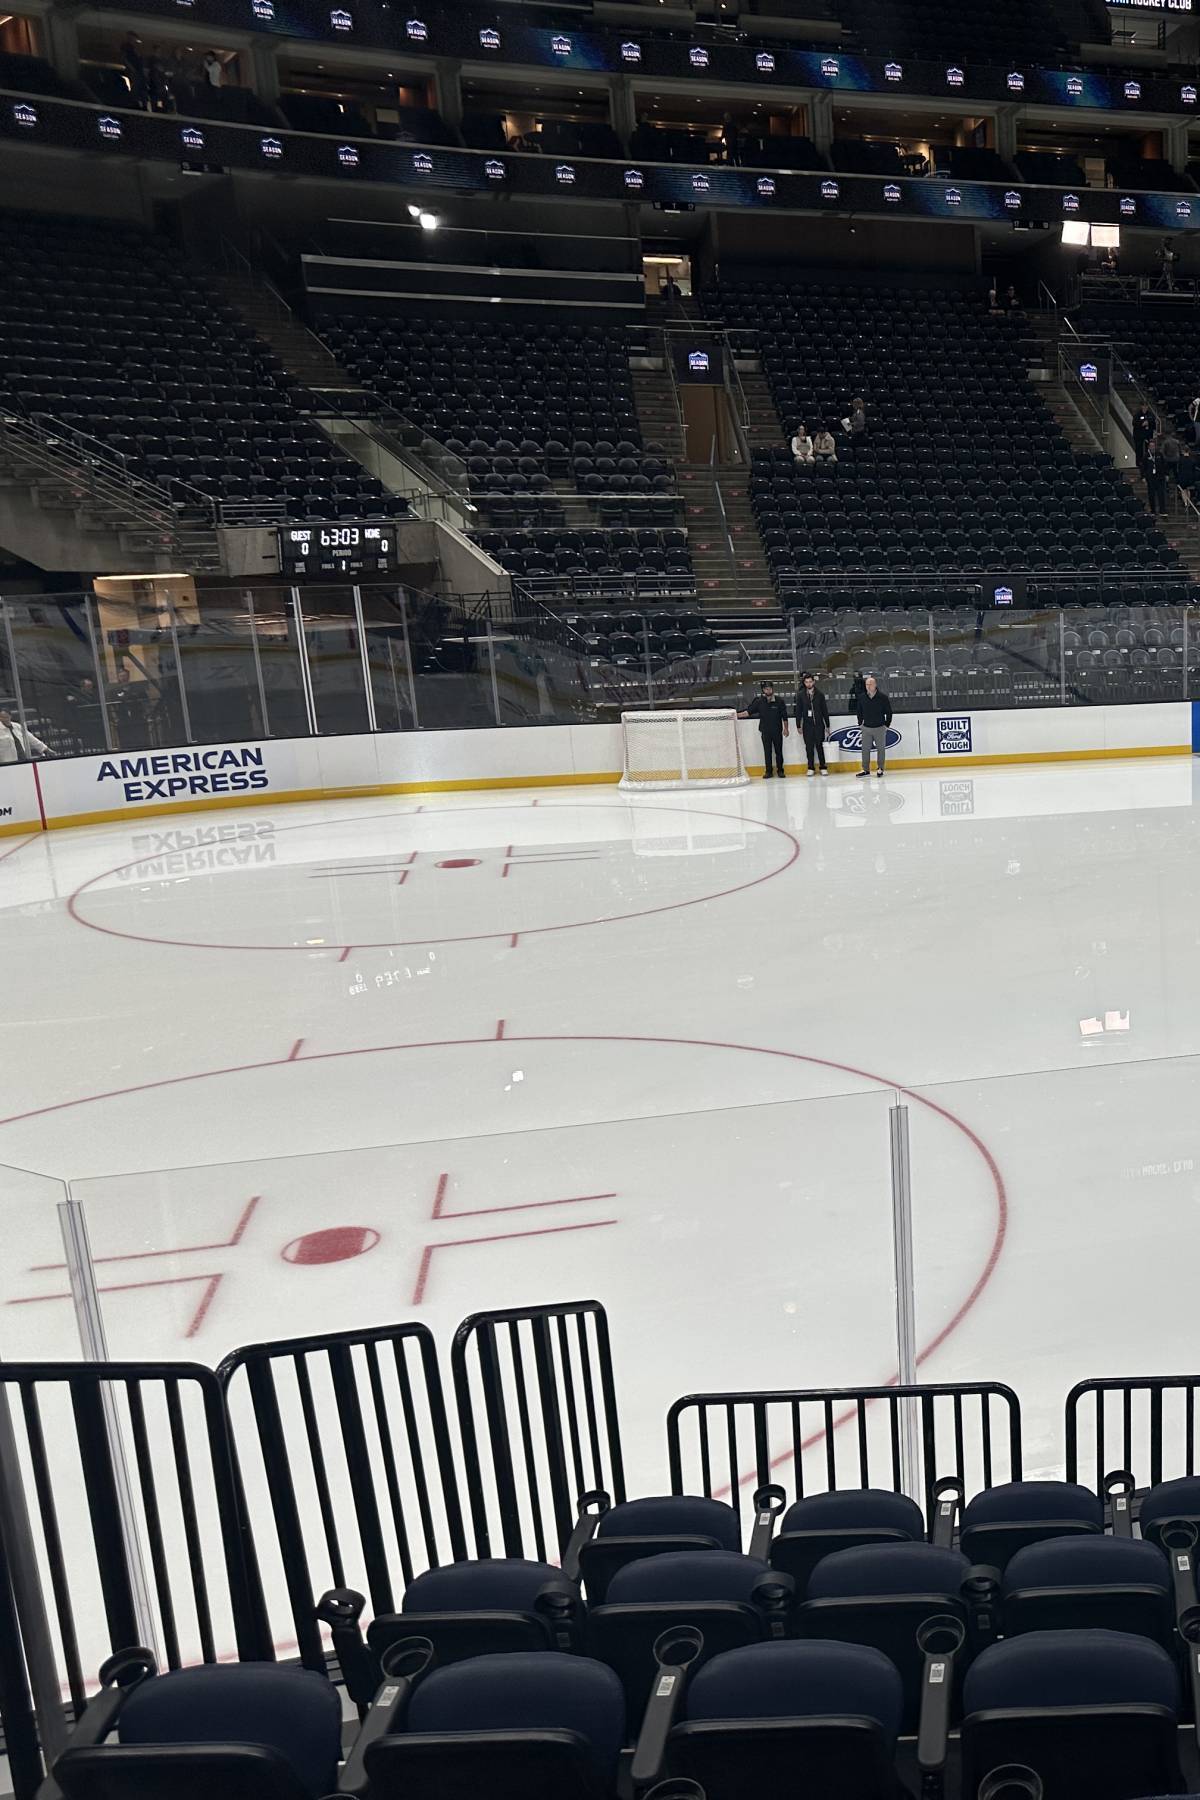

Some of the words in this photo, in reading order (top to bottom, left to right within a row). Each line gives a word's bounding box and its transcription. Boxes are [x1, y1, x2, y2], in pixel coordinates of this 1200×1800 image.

[291, 531, 311, 541] GUEST
[321, 528, 359, 545] 63:03
[365, 529, 380, 538] HOME
[302, 543, 309, 555] 0
[382, 540, 388, 551] 0
[941, 721, 967, 730] BUILT
[941, 742, 968, 750] TOUGH
[97, 748, 263, 781] AMERICAN
[124, 770, 268, 801] EXPRESS
